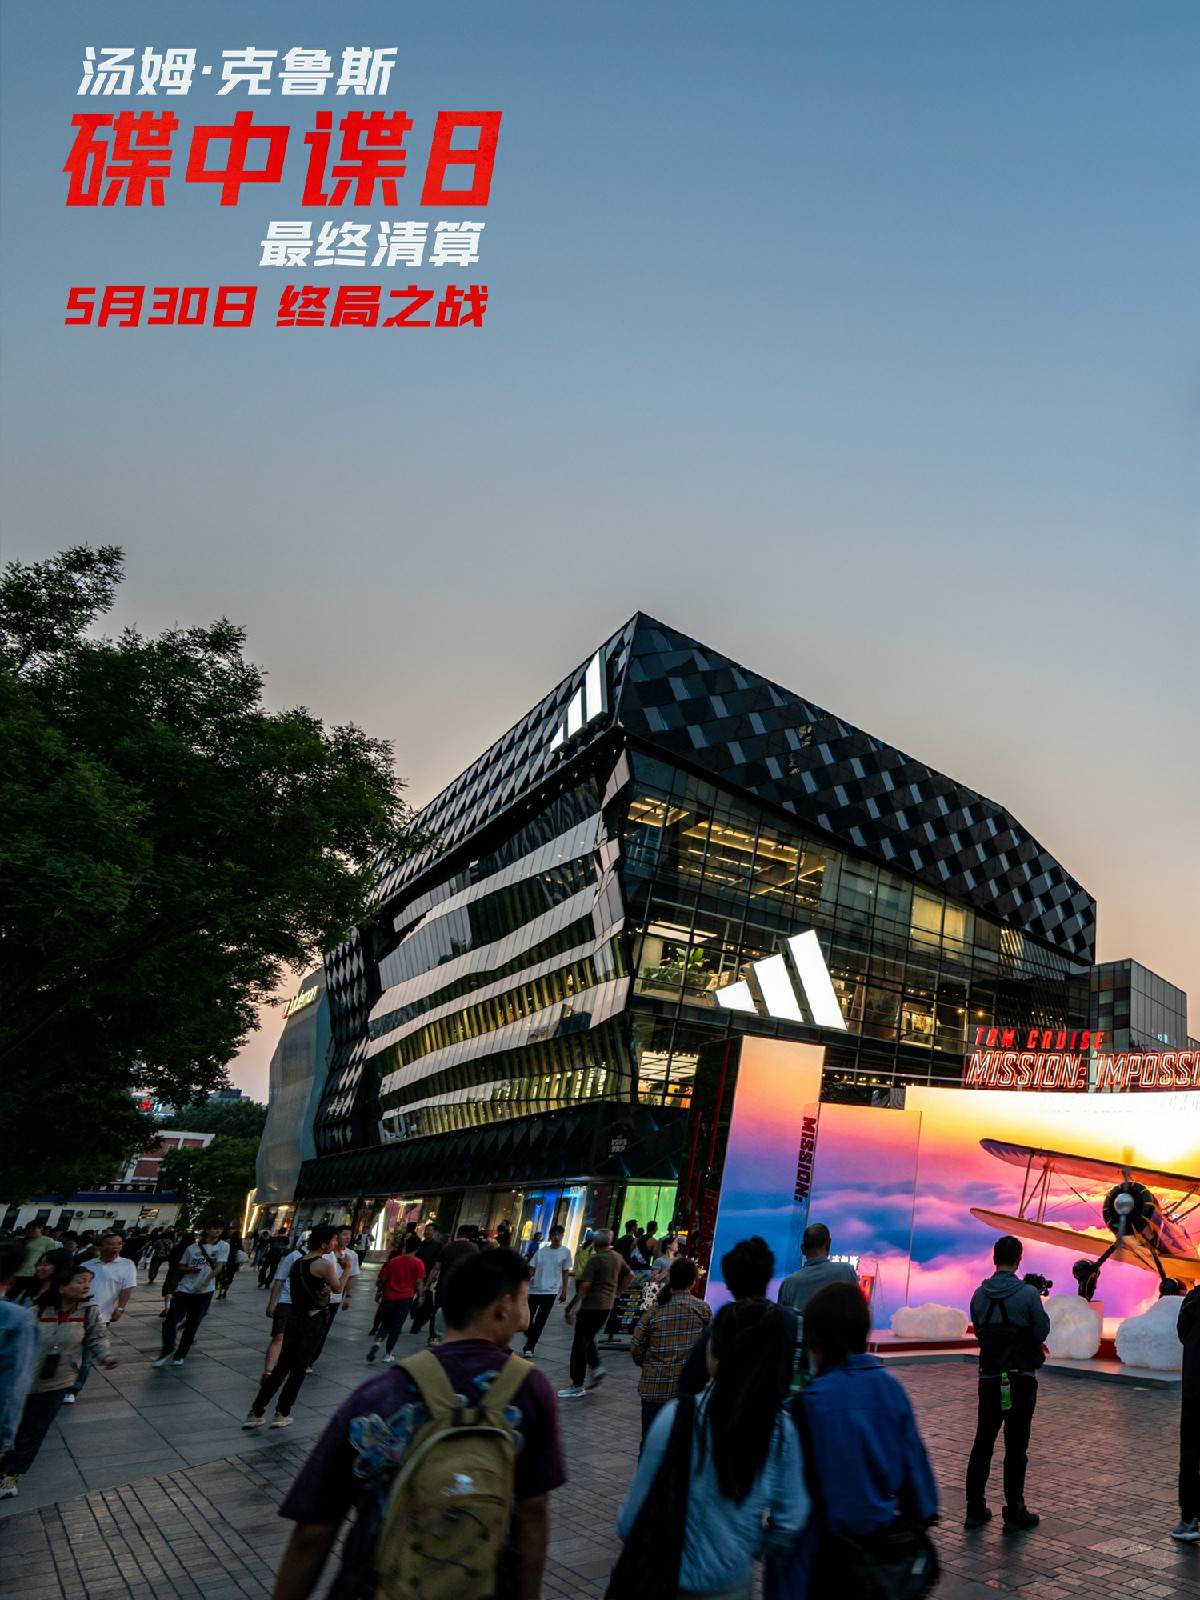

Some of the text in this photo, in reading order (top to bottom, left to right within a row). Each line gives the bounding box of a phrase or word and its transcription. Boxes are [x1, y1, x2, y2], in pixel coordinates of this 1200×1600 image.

[975, 1027, 1105, 1049] TOM CRUISE
[966, 1050, 1087, 1087] MISSION:
